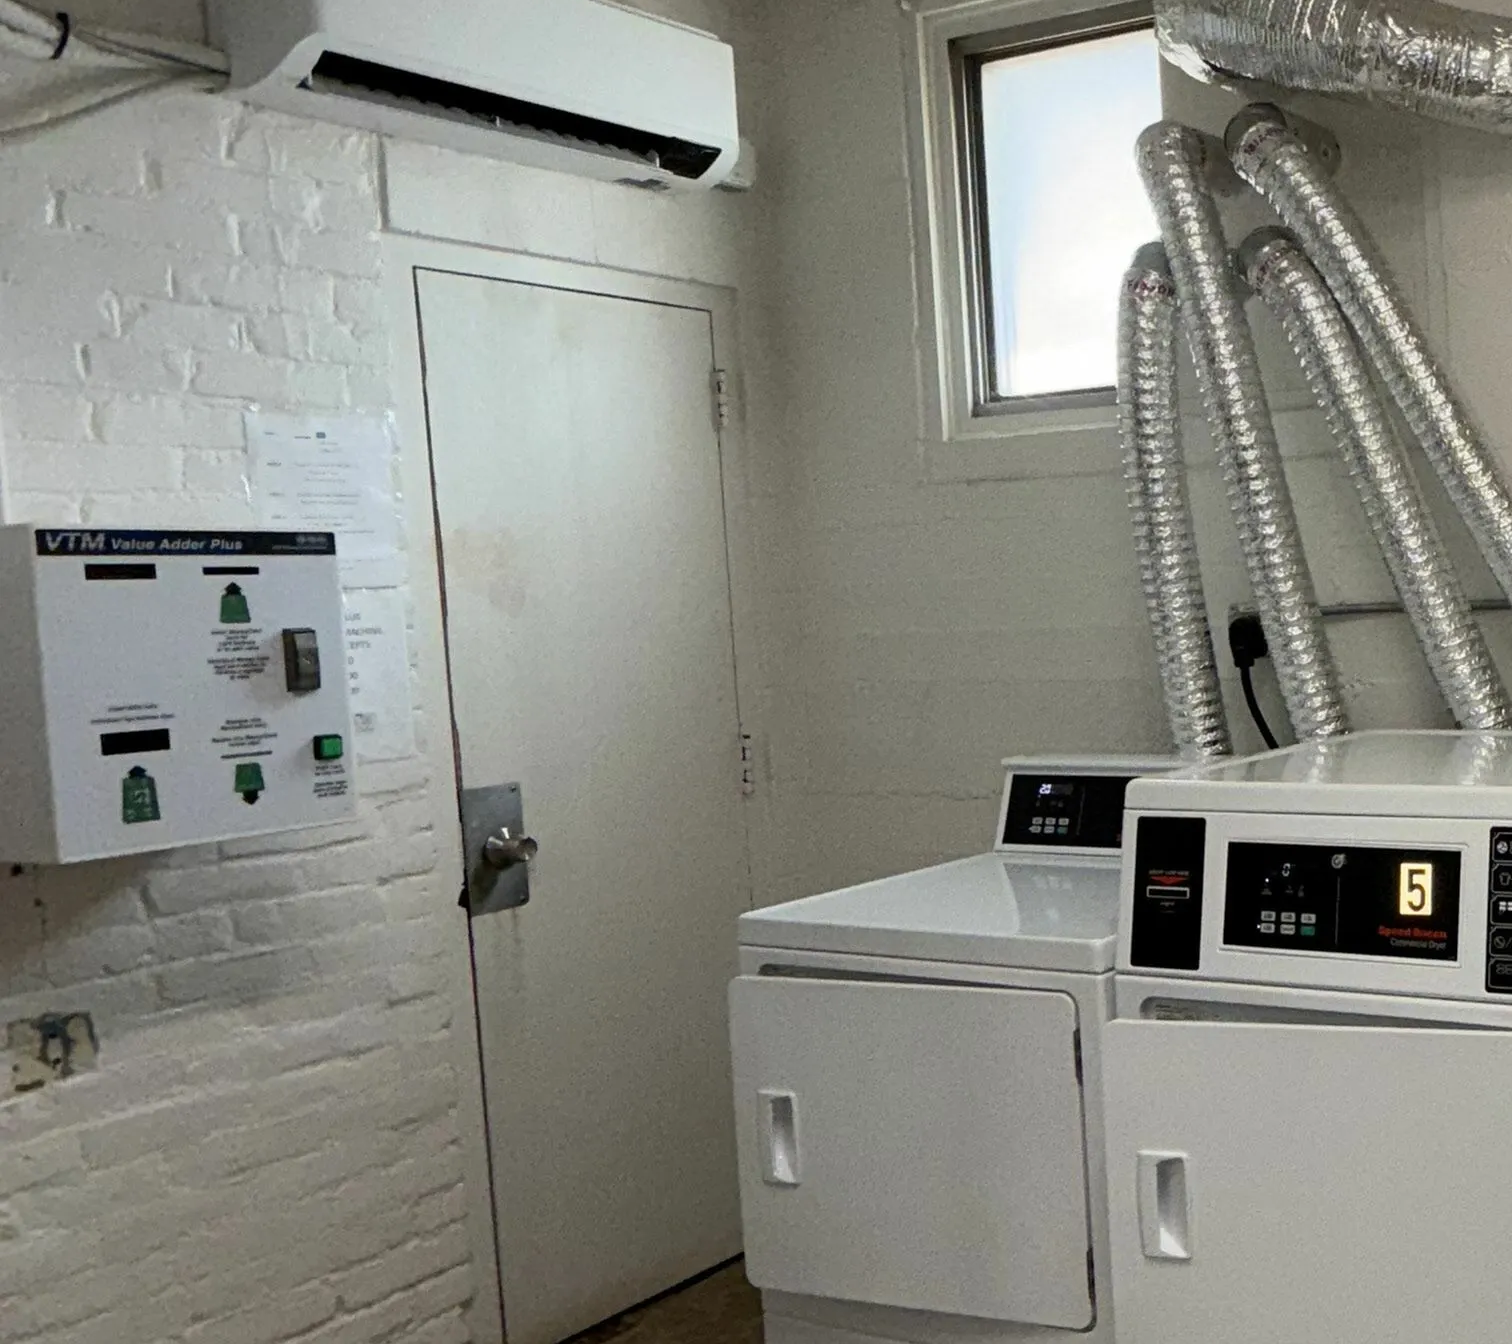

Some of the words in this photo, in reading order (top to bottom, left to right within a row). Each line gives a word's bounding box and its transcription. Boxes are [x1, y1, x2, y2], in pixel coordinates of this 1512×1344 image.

[45, 531, 106, 552] VTM
[111, 537, 155, 550] Value
[159, 538, 205, 551] Adder
[209, 538, 243, 550] Plus
[1407, 869, 1426, 912] 5
